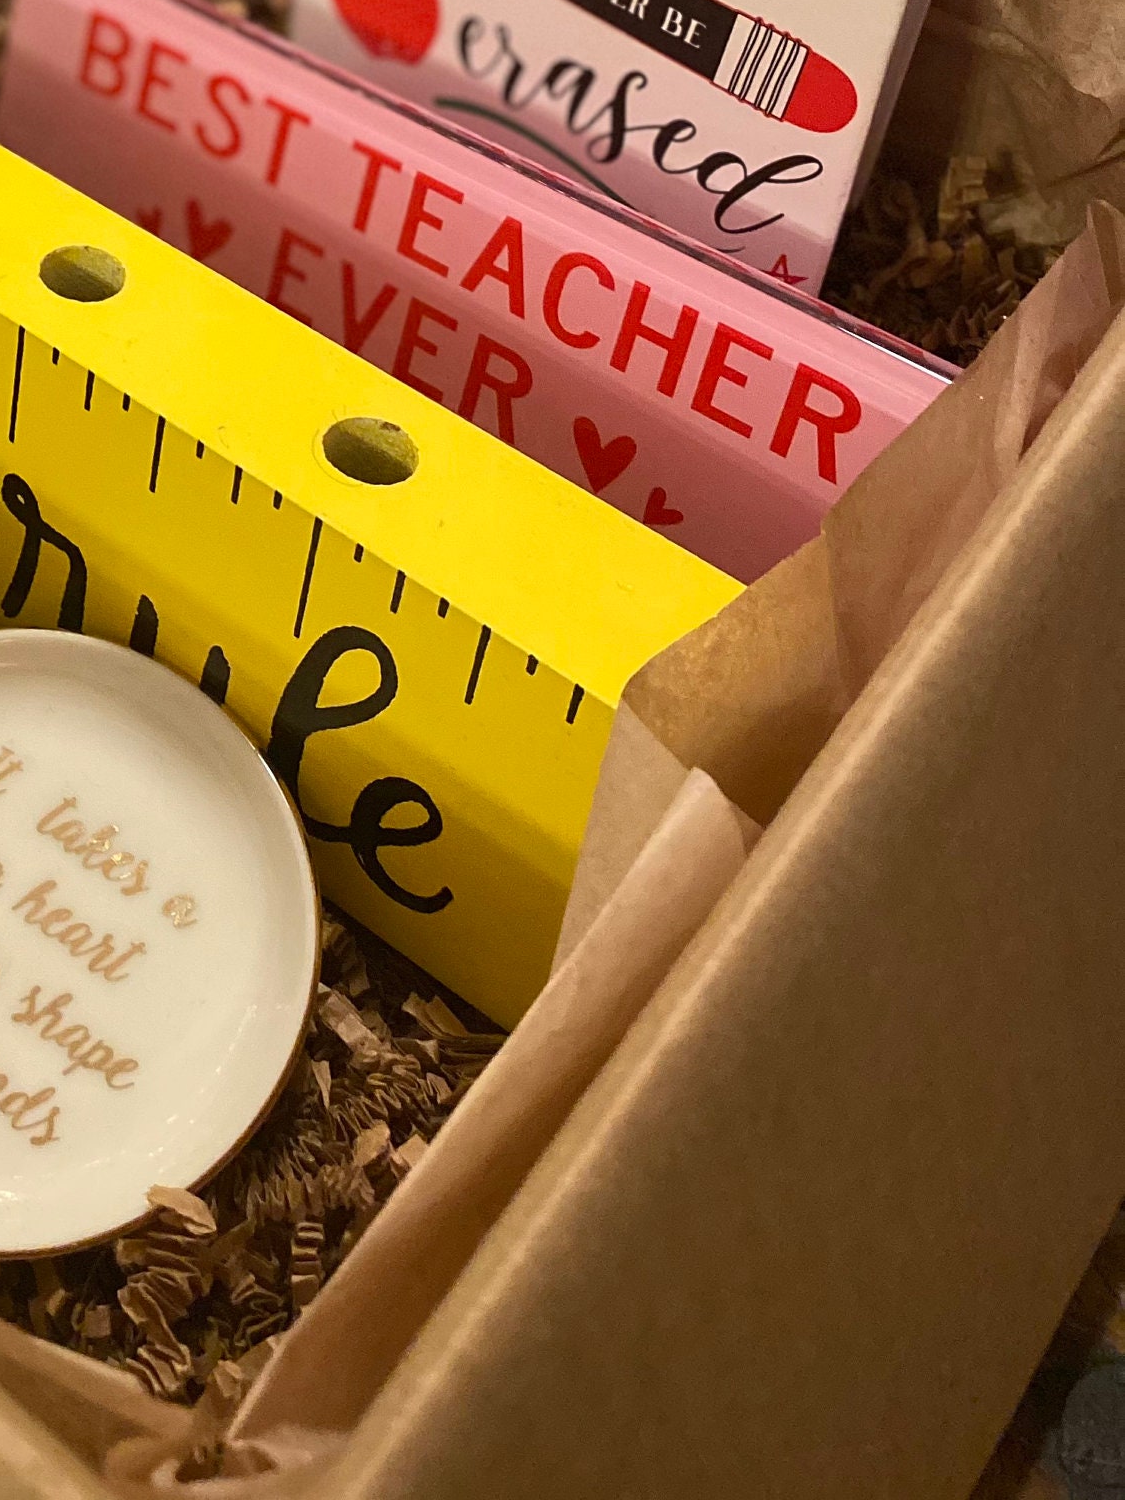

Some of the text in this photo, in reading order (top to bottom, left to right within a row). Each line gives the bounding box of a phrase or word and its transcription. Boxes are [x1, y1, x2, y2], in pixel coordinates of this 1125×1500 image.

[660, 6, 707, 49] BE
[454, 15, 823, 234] erased
[79, 12, 864, 485] BEST TEACHER
[267, 228, 533, 445] EVER
[36, 797, 149, 895] takes
[162, 894, 197, 928] a
[12, 879, 146, 983] heart
[12, 985, 139, 1090] shape
